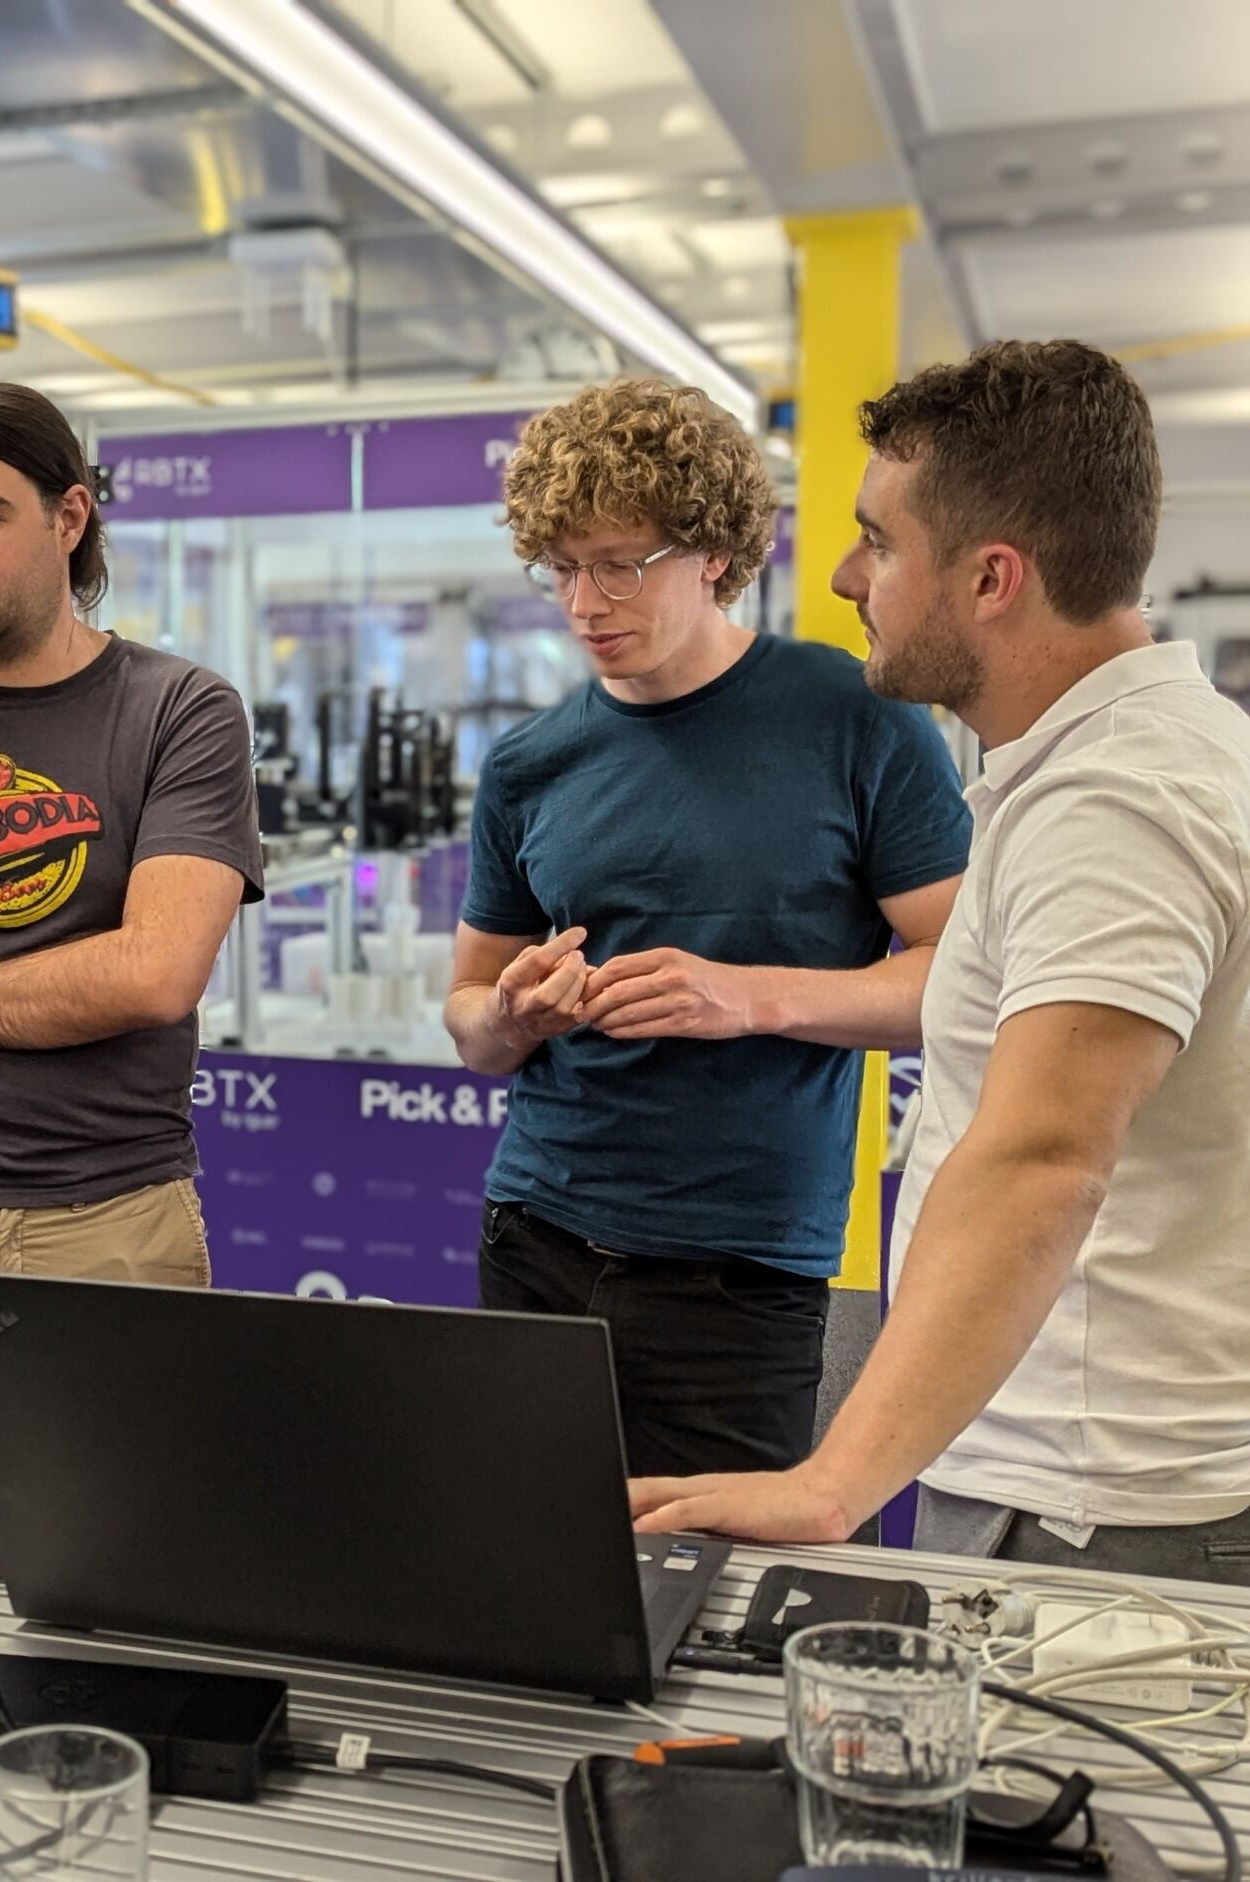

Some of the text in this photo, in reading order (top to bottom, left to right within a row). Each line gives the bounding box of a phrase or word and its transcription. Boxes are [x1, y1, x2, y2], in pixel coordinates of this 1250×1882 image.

[190, 1069, 509, 1128] BTX Pick & P
